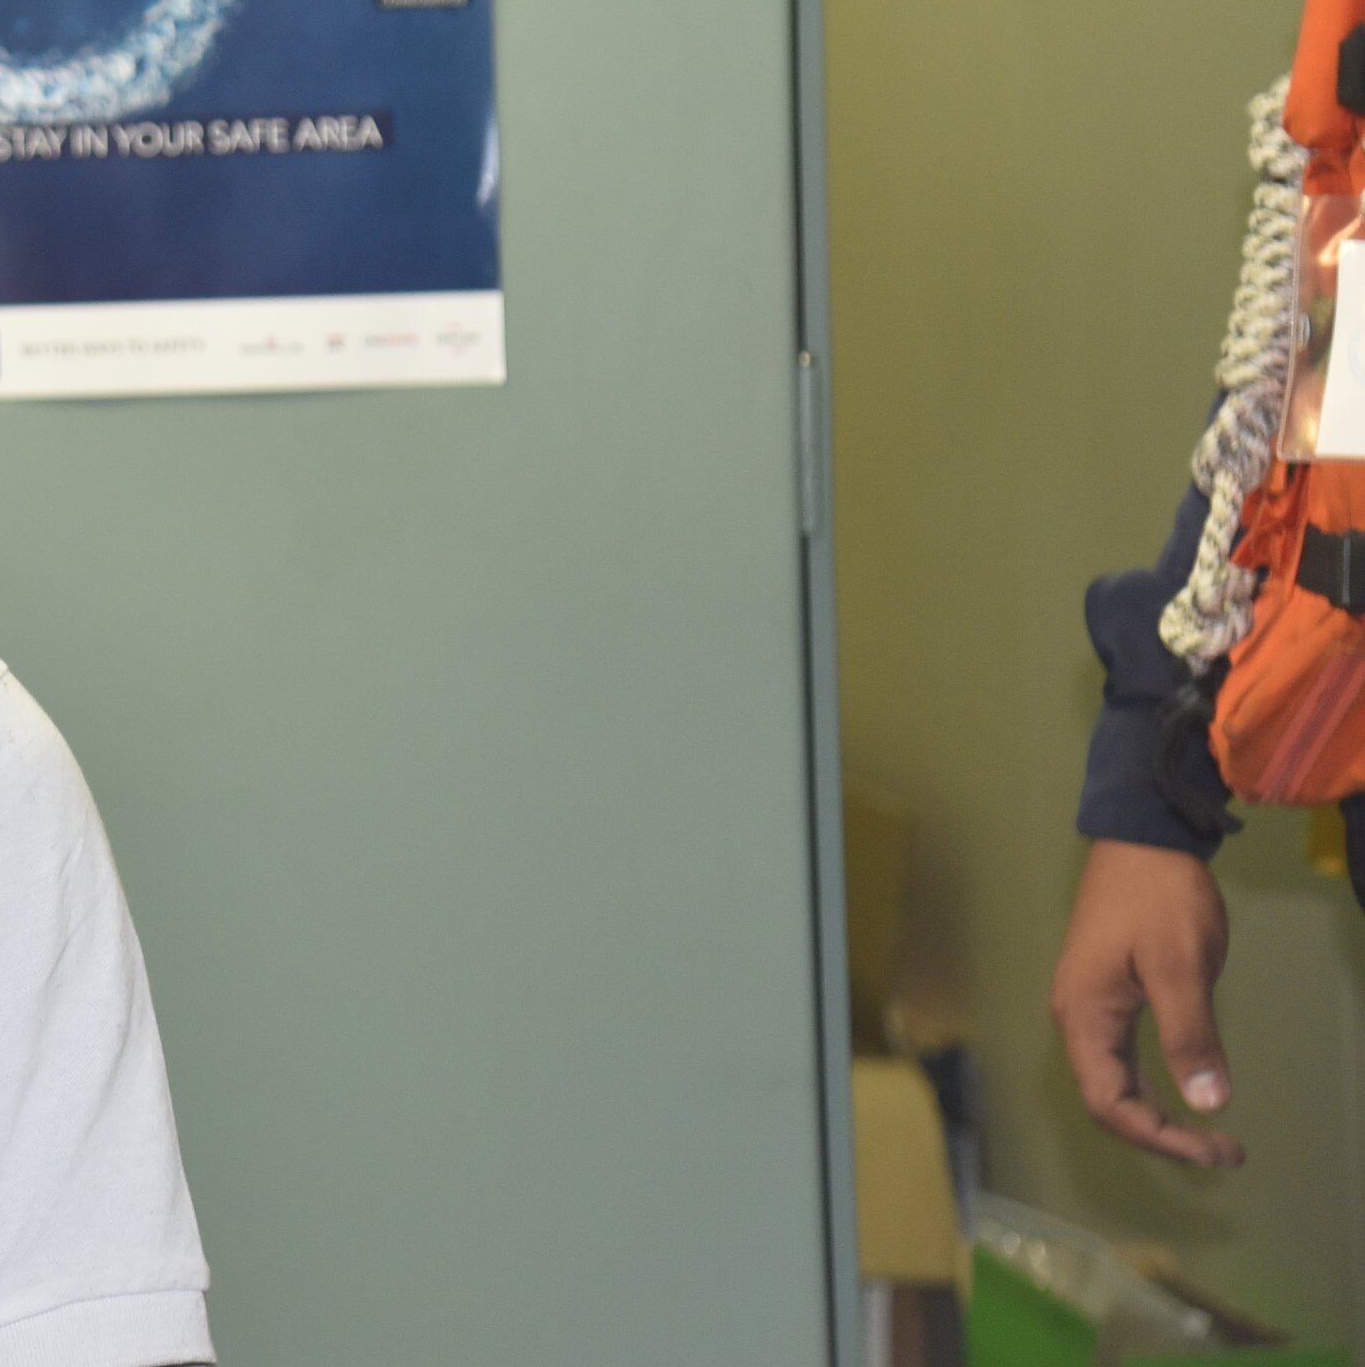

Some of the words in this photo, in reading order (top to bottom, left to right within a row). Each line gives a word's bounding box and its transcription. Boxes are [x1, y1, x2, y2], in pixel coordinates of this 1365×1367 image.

[70, 122, 108, 159] IN
[112, 119, 204, 158] YOUR
[207, 118, 289, 156] SAFE
[294, 115, 384, 153] AREA
